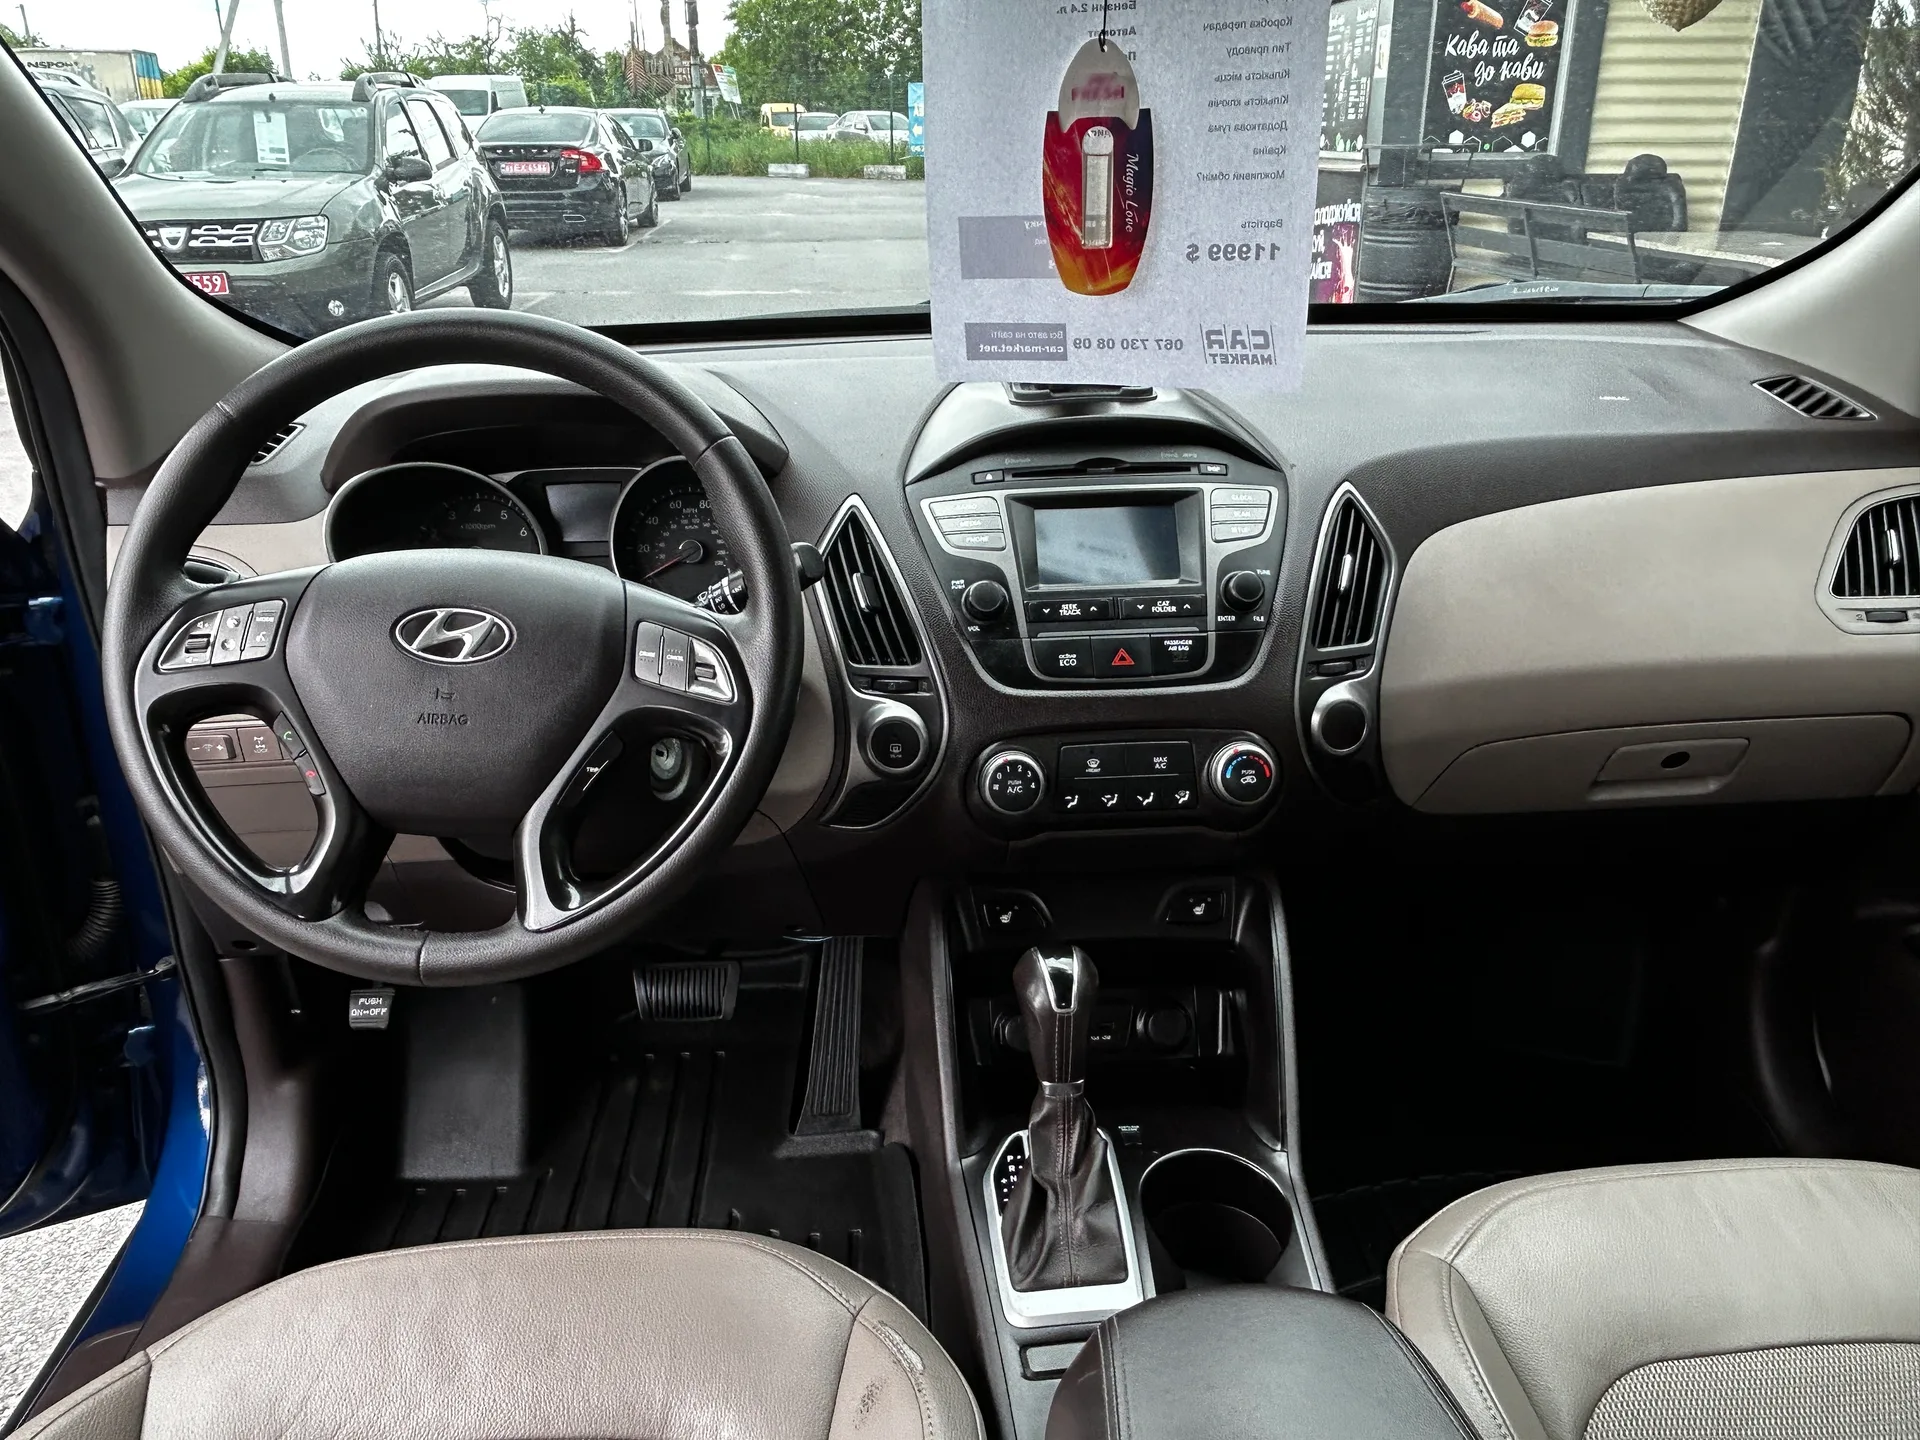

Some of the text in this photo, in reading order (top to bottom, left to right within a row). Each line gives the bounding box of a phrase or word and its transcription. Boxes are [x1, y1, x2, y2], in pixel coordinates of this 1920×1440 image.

[1444, 30, 1520, 59] Кава та
[1474, 53, 1545, 87] до кави
[1125, 200, 1139, 233] Love
[473, 503, 481, 513] 4
[669, 500, 682, 510] 60
[500, 510, 508, 520] 5
[646, 516, 659, 526] 40
[519, 526, 528, 537] 6
[1059, 608, 1082, 616] TRACK
[1152, 605, 1177, 613] FOLDER
[1059, 658, 1077, 667] ECO
[417, 712, 469, 726] AIRBAG
[1007, 785, 1023, 794] A/C
[358, 997, 383, 1005] PUSH
[1006, 1155, 1014, 1163] P
[1009, 1174, 1018, 1183] N
